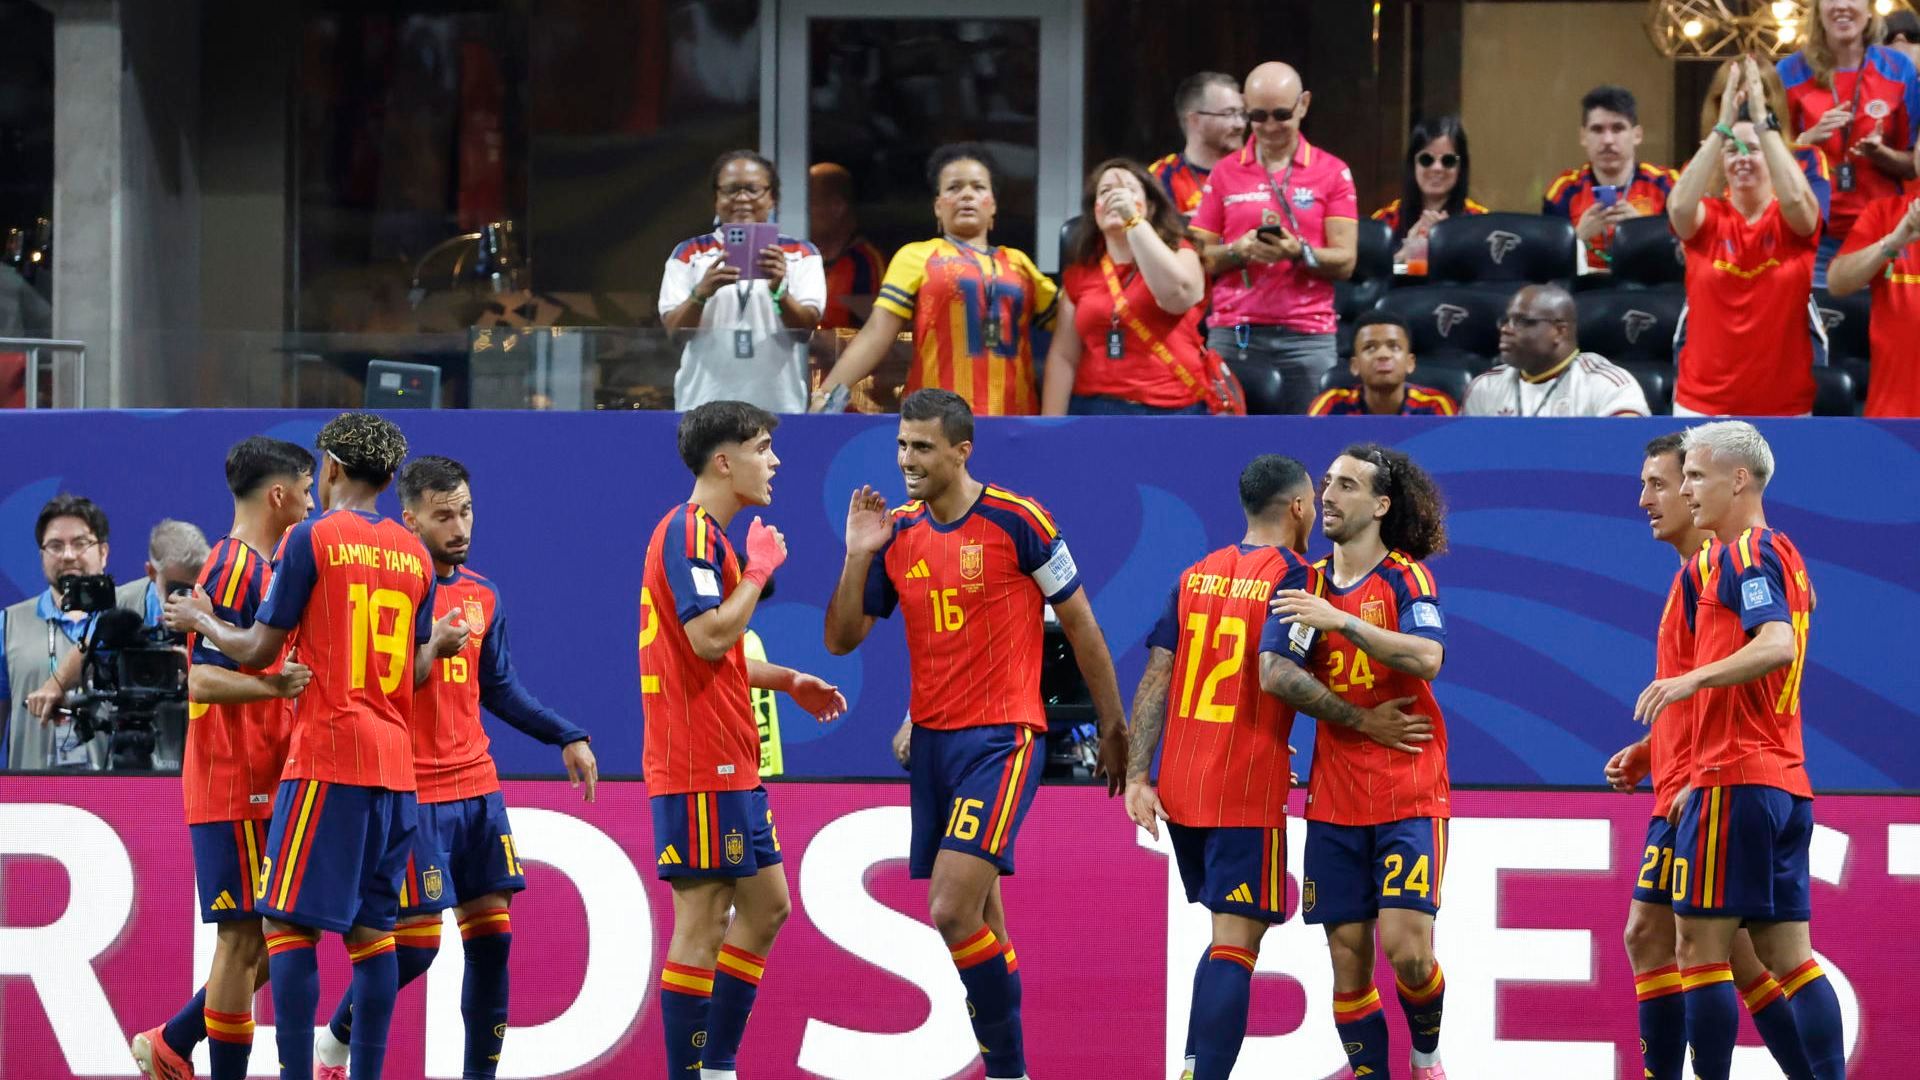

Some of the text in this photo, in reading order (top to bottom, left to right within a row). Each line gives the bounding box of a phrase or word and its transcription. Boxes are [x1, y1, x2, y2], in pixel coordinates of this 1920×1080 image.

[957, 278, 1024, 357] 10
[327, 543, 380, 569] LAMINE
[930, 588, 964, 633] 16
[1229, 578, 1271, 602] PORRO
[349, 584, 413, 695] 19
[443, 656, 468, 683] 15
[1178, 611, 1247, 723] 12
[1326, 648, 1375, 692] 24
[945, 797, 984, 840] 16
[1382, 854, 1430, 898] 24
[1637, 845, 1673, 890] 21
[1672, 857, 1688, 901] 0
